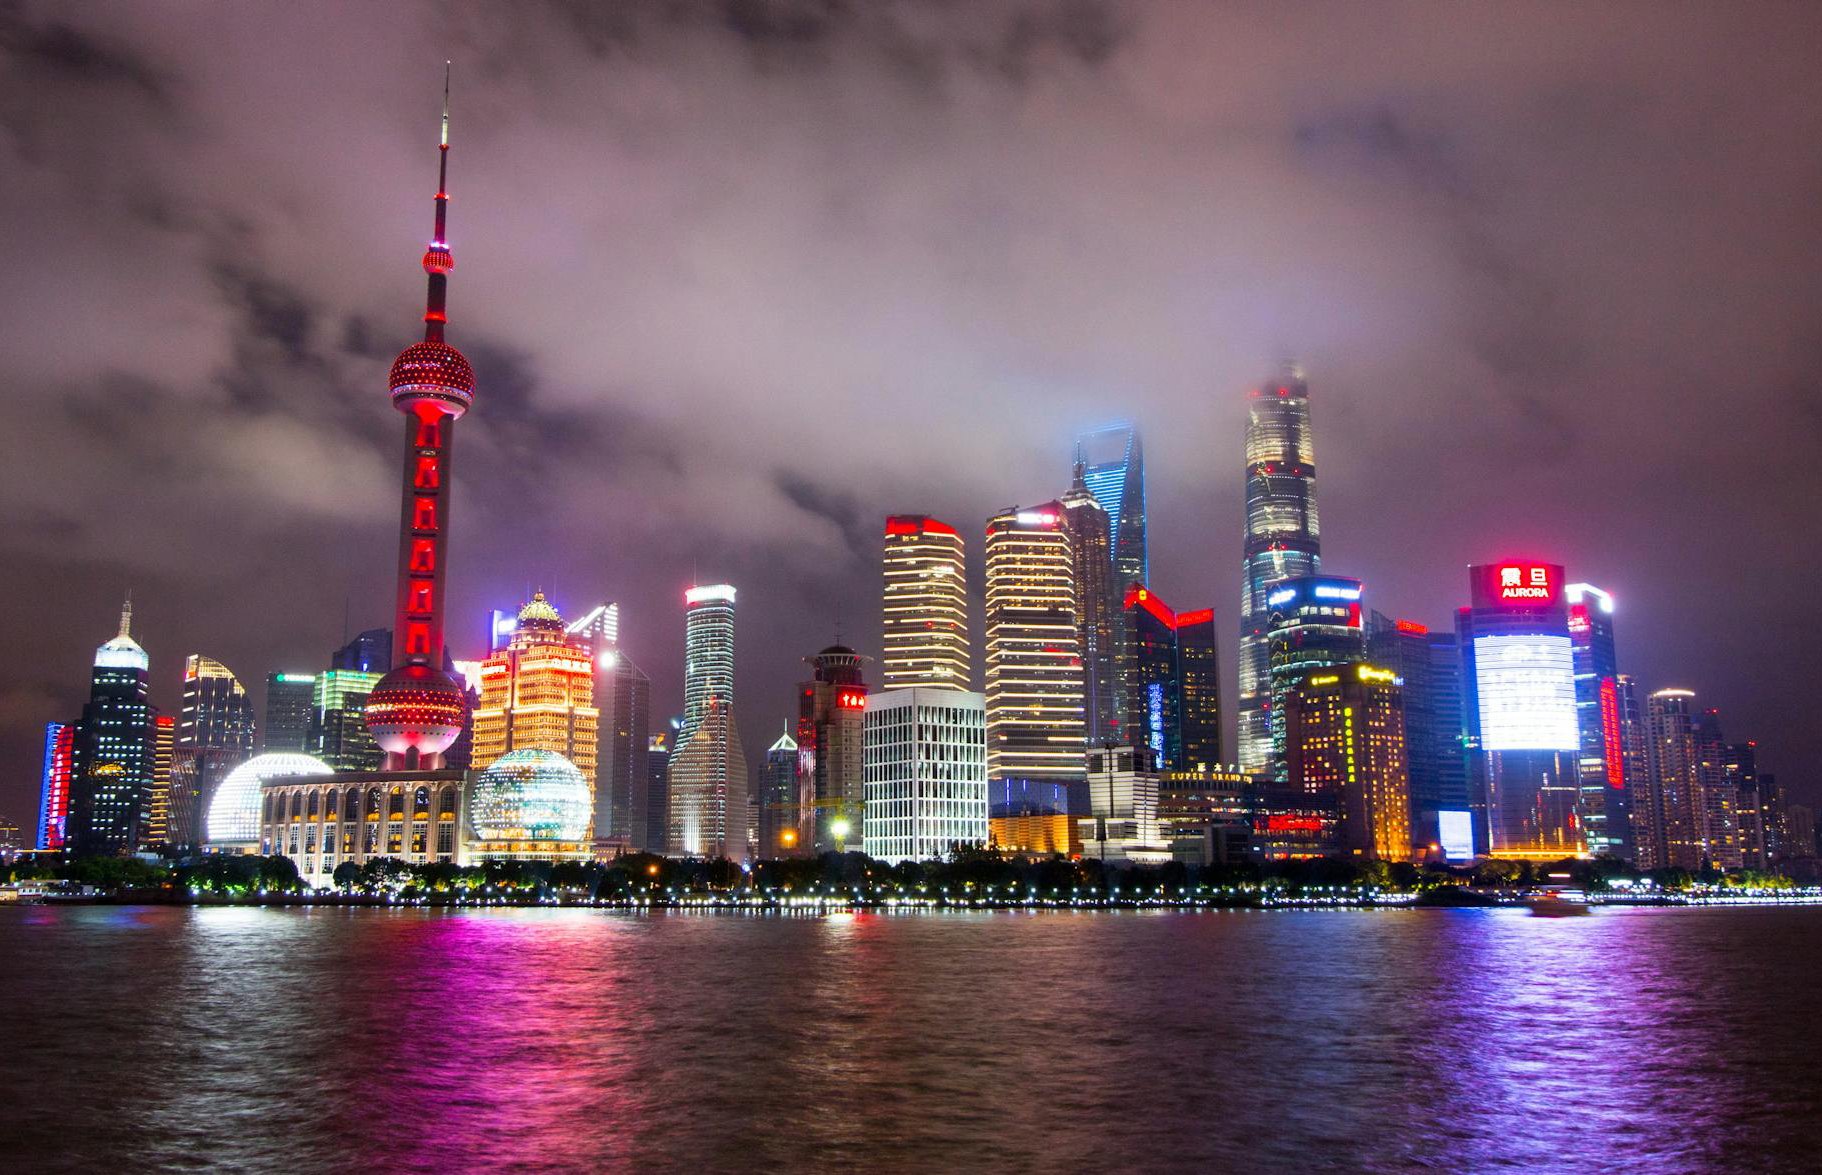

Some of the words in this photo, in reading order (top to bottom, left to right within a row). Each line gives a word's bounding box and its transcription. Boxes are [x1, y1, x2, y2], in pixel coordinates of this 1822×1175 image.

[1502, 587, 1549, 598] AURORA
[1170, 772, 1205, 781] SUPER
[1212, 773, 1241, 782] BRAND
